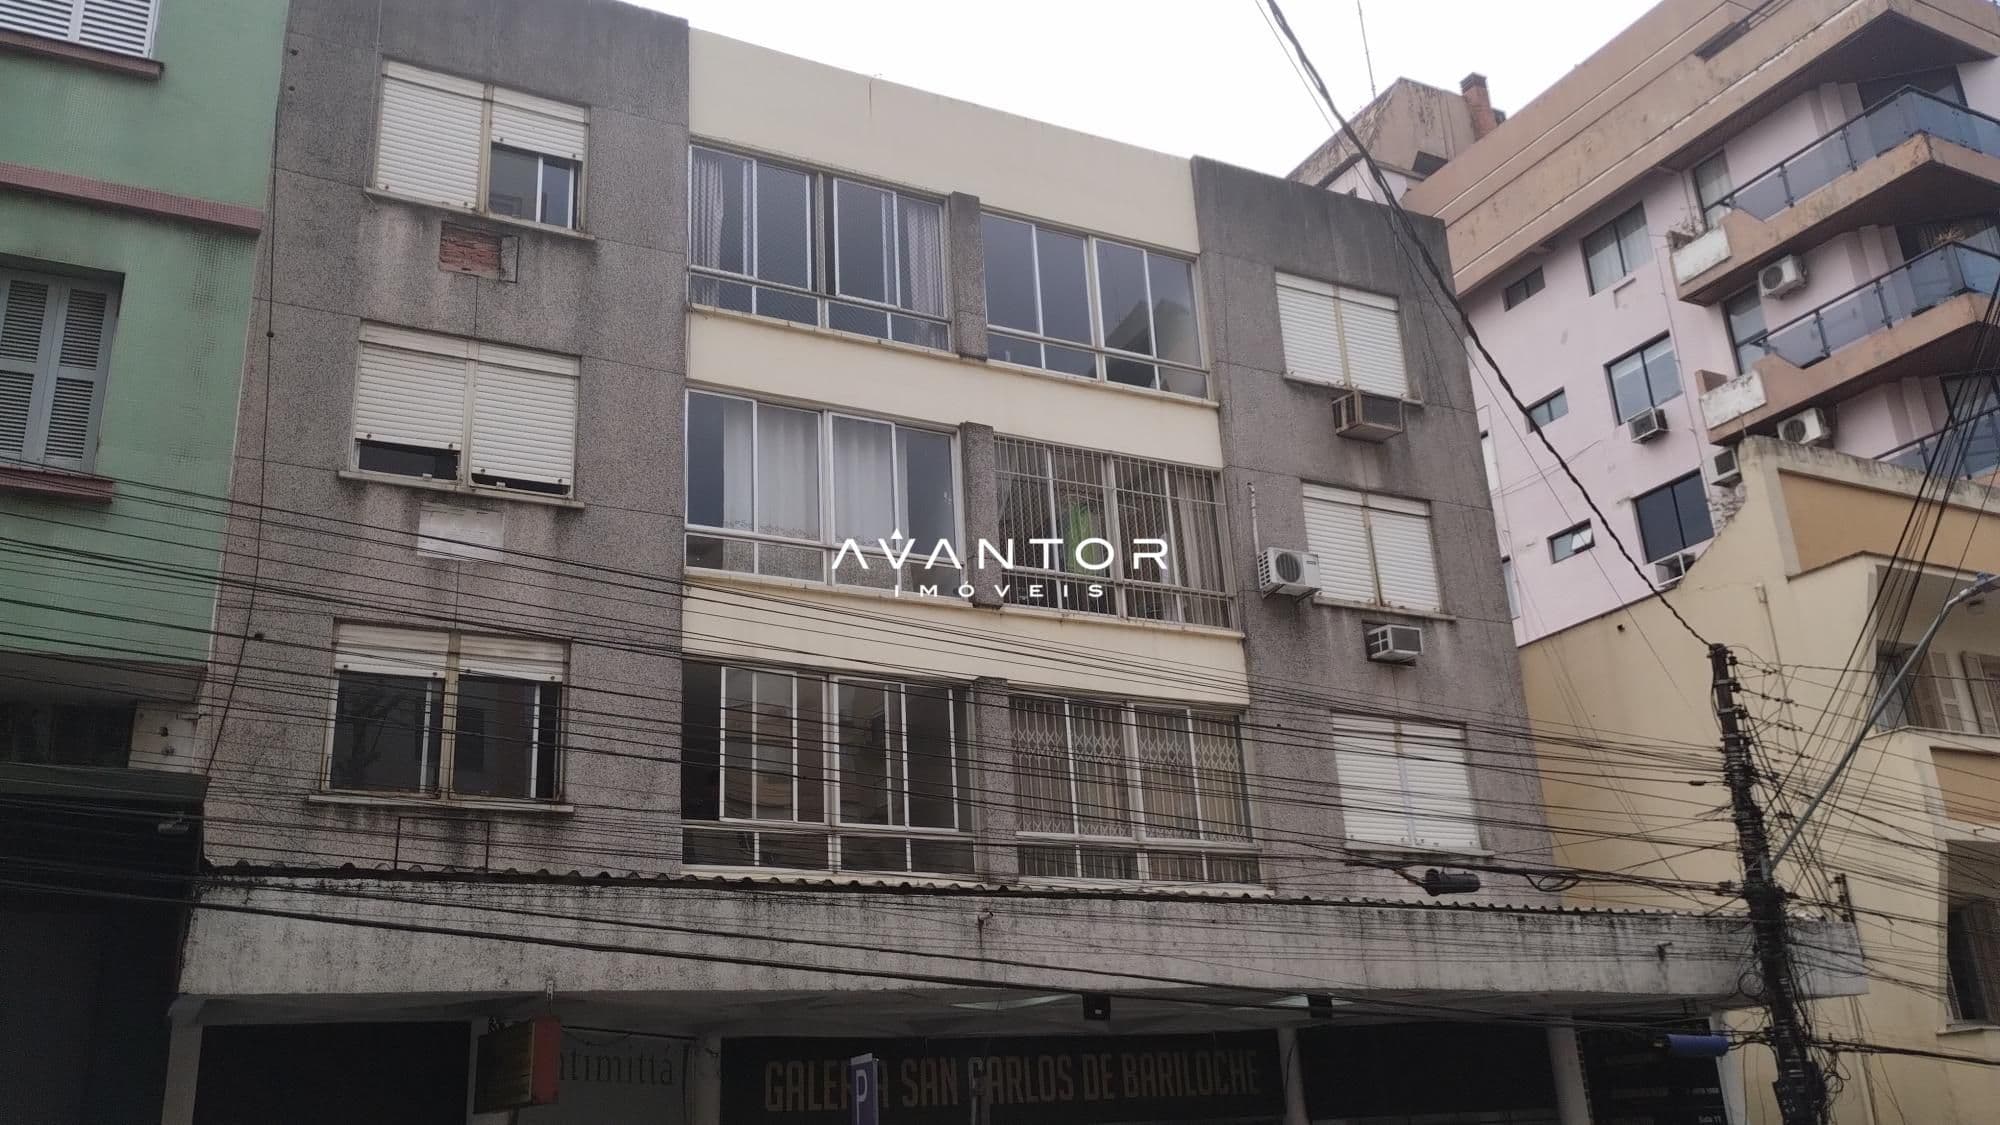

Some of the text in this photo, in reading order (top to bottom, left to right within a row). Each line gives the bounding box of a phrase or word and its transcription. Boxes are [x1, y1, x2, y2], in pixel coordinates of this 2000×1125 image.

[902, 1056, 959, 1106] SAN
[968, 1055, 1074, 1104] CARLOS
[1082, 1054, 1116, 1100] DE
[1121, 1050, 1259, 1098] BARILOCHE
